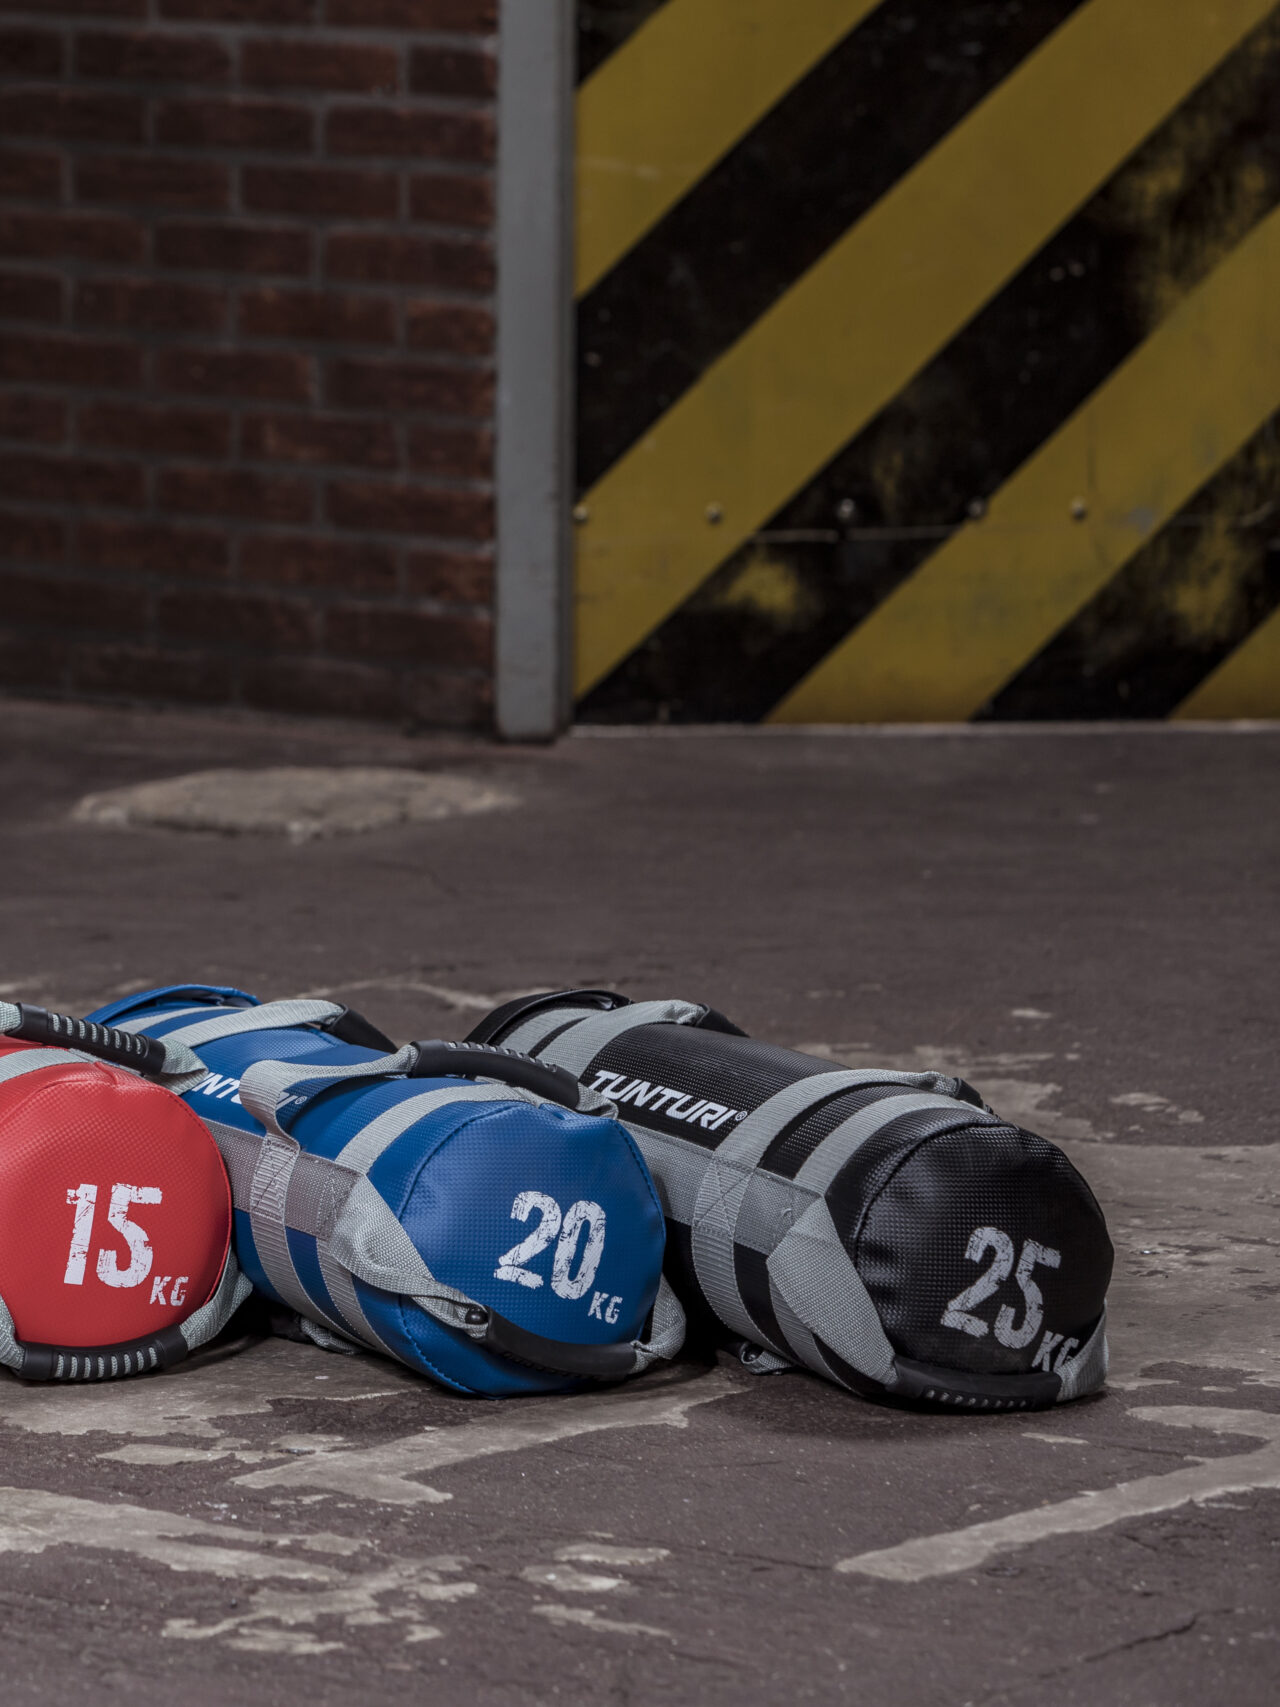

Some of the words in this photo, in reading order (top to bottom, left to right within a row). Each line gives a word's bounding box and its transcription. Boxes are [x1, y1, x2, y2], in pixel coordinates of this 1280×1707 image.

[63, 1182, 163, 1288] 15
[149, 1276, 189, 1306] KG
[493, 1191, 606, 1300] 20
[587, 1291, 623, 1324] KG
[940, 1226, 1062, 1349] 25
